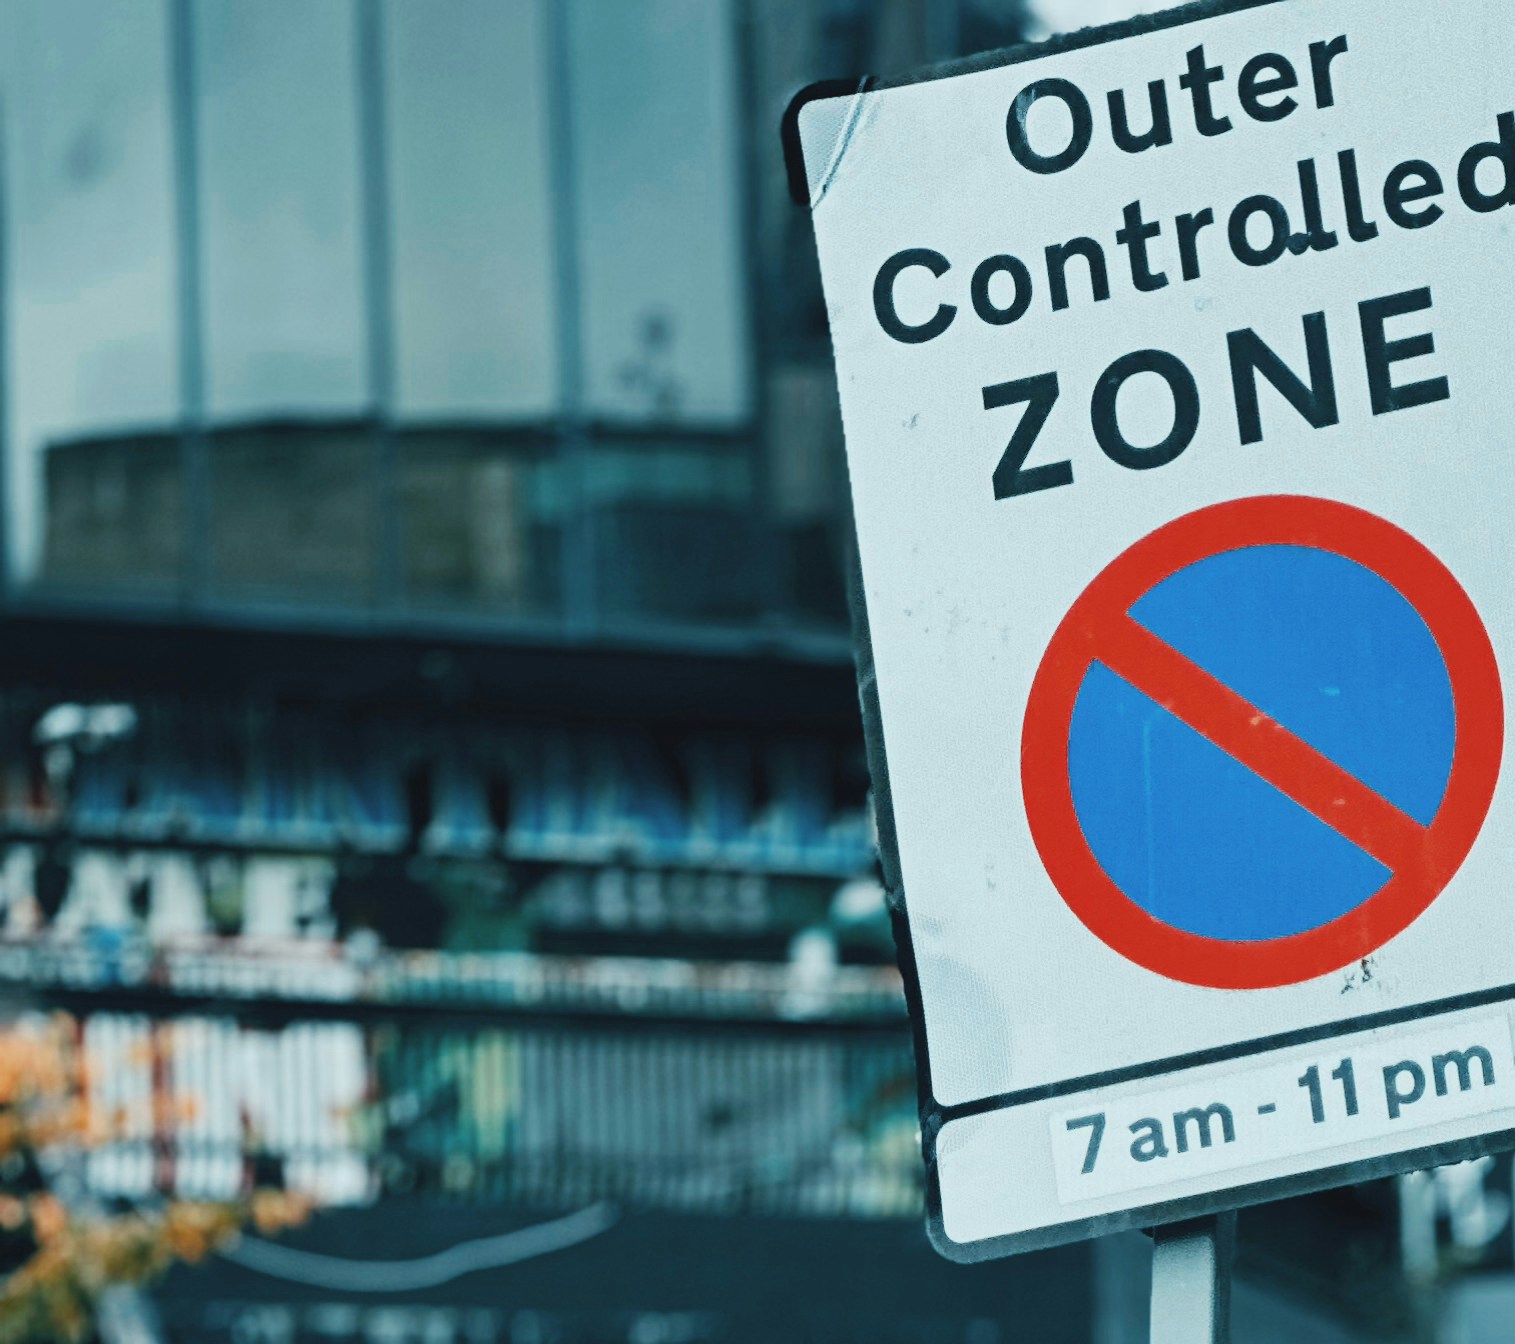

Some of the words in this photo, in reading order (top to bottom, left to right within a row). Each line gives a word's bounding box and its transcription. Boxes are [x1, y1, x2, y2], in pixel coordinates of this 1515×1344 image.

[1006, 34, 1349, 175] Outer
[982, 287, 1451, 501] ZONE
[1066, 1112, 1106, 1174] 7
[1128, 1102, 1235, 1162] am
[1297, 1056, 1360, 1124] 11
[1382, 1042, 1496, 1120] pm
